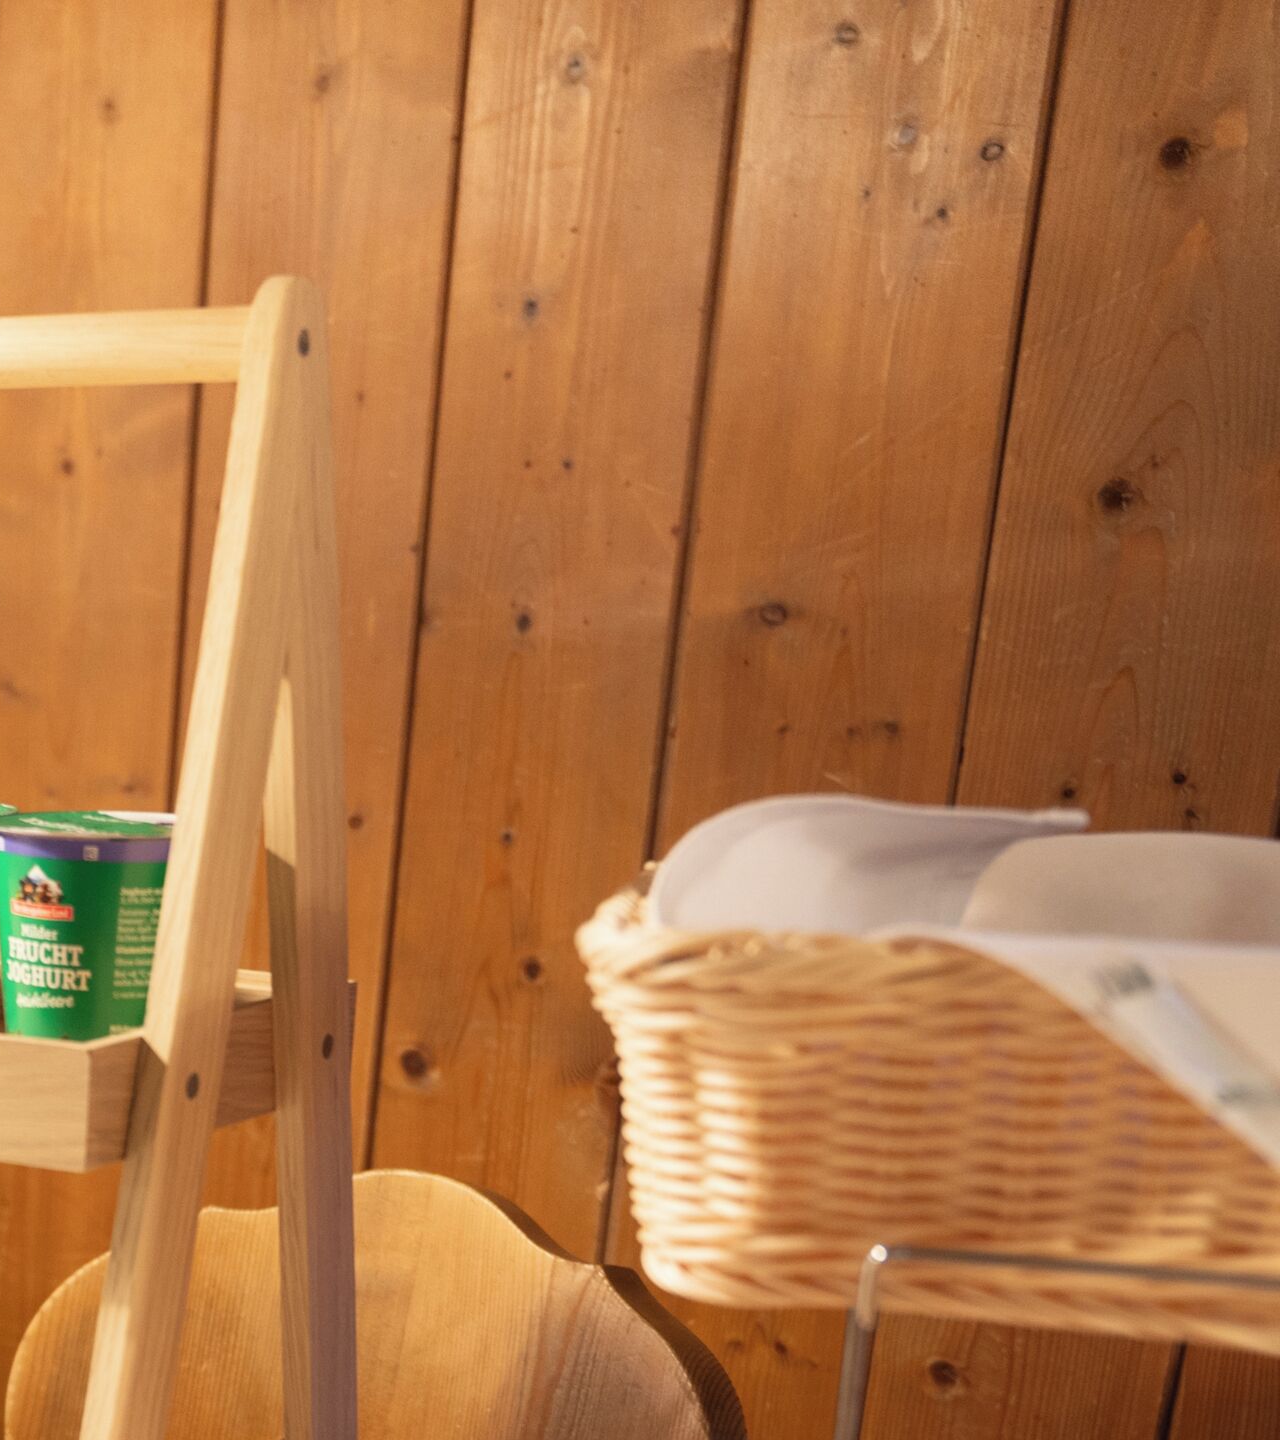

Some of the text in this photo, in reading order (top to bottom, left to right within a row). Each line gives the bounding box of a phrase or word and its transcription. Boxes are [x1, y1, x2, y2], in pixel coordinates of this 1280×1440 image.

[20, 923, 59, 941] Milder
[7, 936, 85, 967] FRUCHT
[6, 959, 92, 991] JOGHURT
